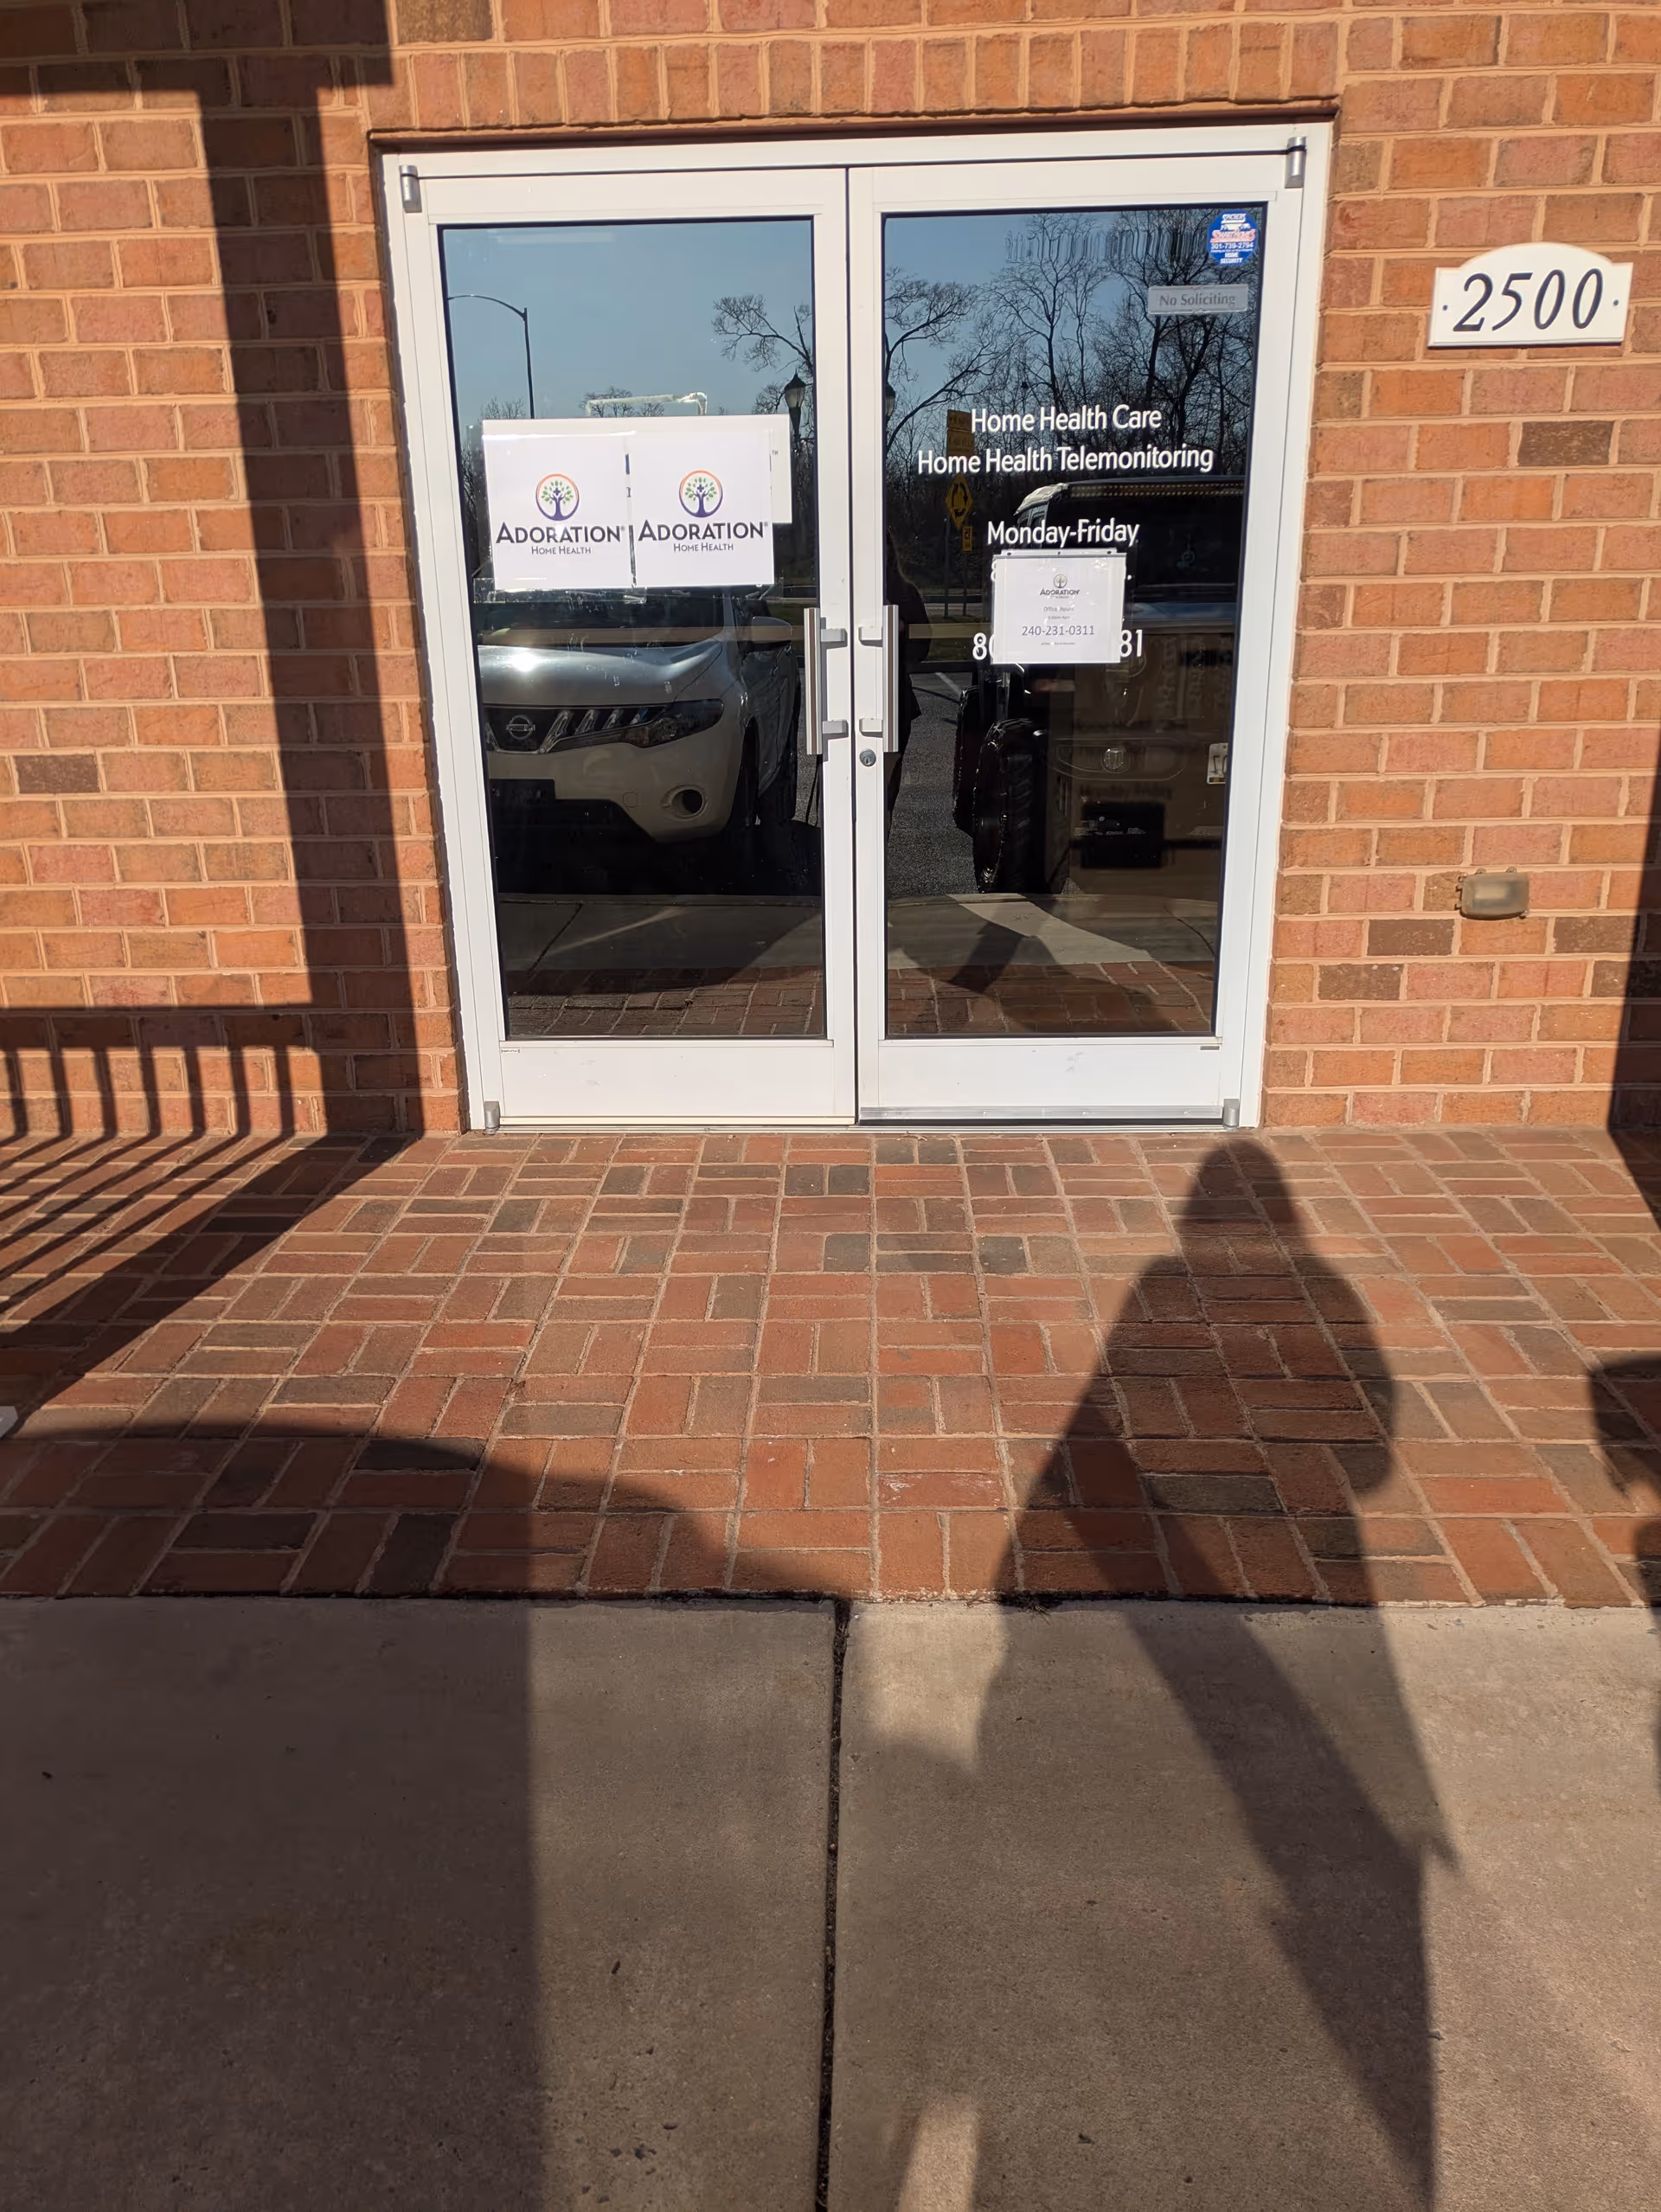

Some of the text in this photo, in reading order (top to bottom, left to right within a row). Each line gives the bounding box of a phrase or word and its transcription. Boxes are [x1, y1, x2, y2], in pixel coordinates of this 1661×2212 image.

[1159, 292, 1235, 307] No Soliciting
[1453, 267, 1604, 332] 2500
[971, 408, 1035, 433] Home
[1040, 404, 1107, 432] Health
[1113, 404, 1162, 430] Care
[918, 442, 1215, 475] Home Health Telemonitoring
[987, 517, 1140, 548] Monday-Friday
[531, 546, 591, 555] HOME HEALTH
[673, 542, 734, 553] HOME HEALTH
[1022, 625, 1095, 636] 240-231-0311
